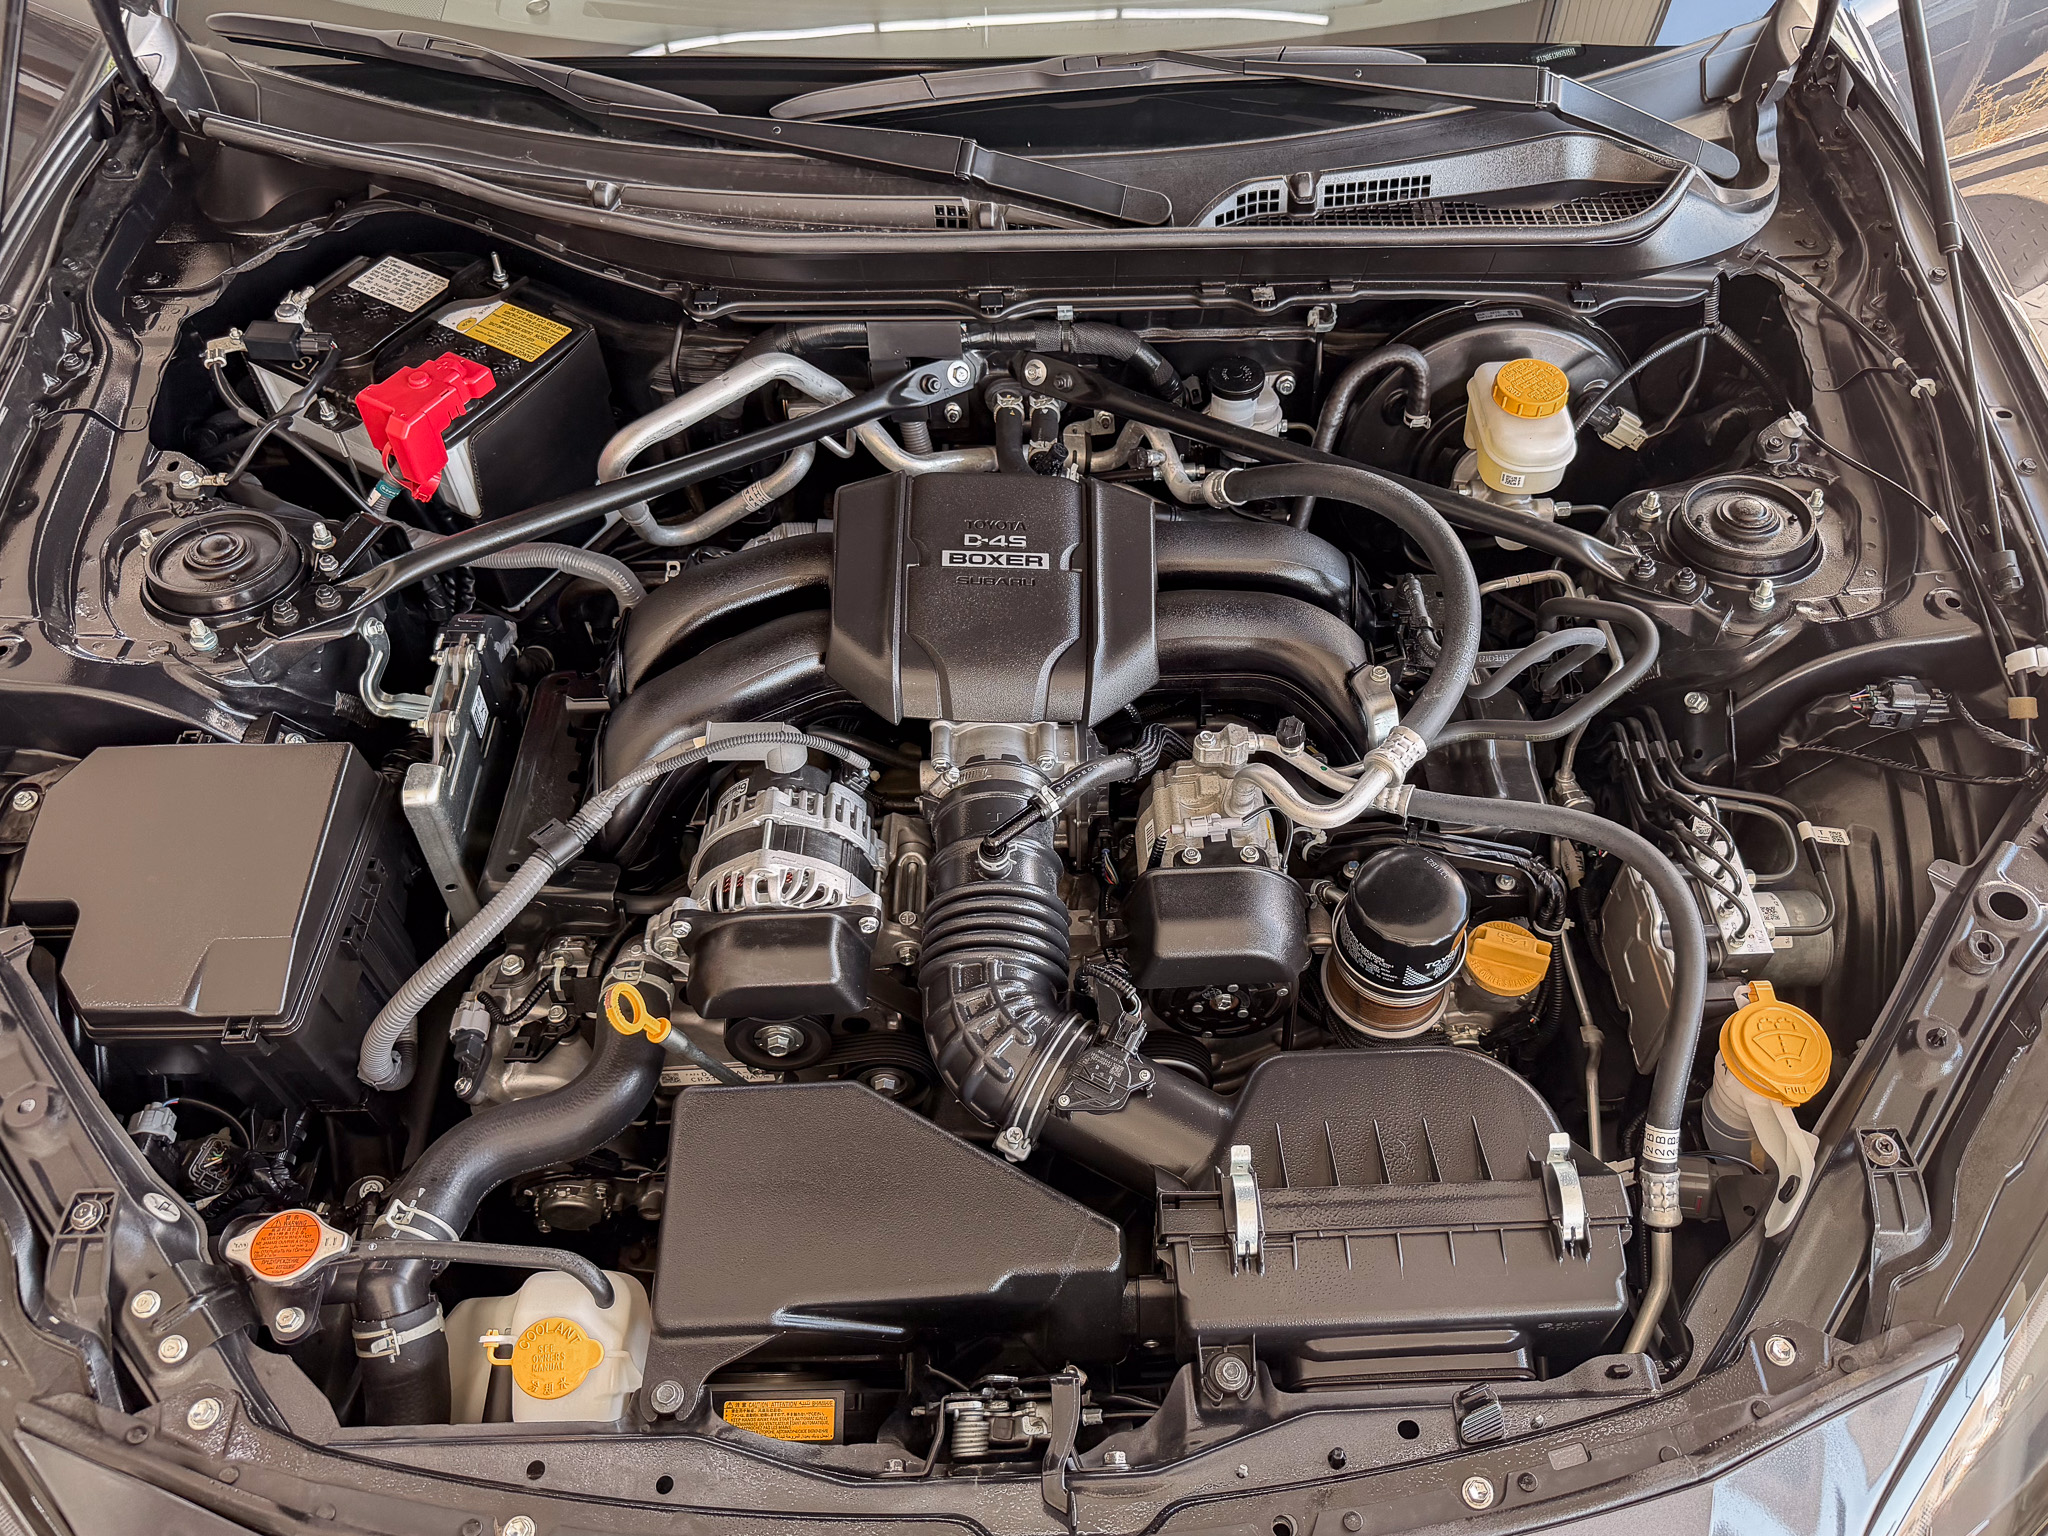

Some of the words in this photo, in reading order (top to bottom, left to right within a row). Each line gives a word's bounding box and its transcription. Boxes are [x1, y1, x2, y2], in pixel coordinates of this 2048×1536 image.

[964, 519, 1027, 531] TOYOTA
[963, 533, 1027, 548] D-4S
[948, 552, 1044, 567] BOXER
[955, 575, 1036, 587] SUBARU
[1784, 1086, 1811, 1095] PULL
[519, 1321, 582, 1350] COOLANT
[538, 1344, 556, 1354] SEE
[531, 1361, 565, 1373] MANUAL
